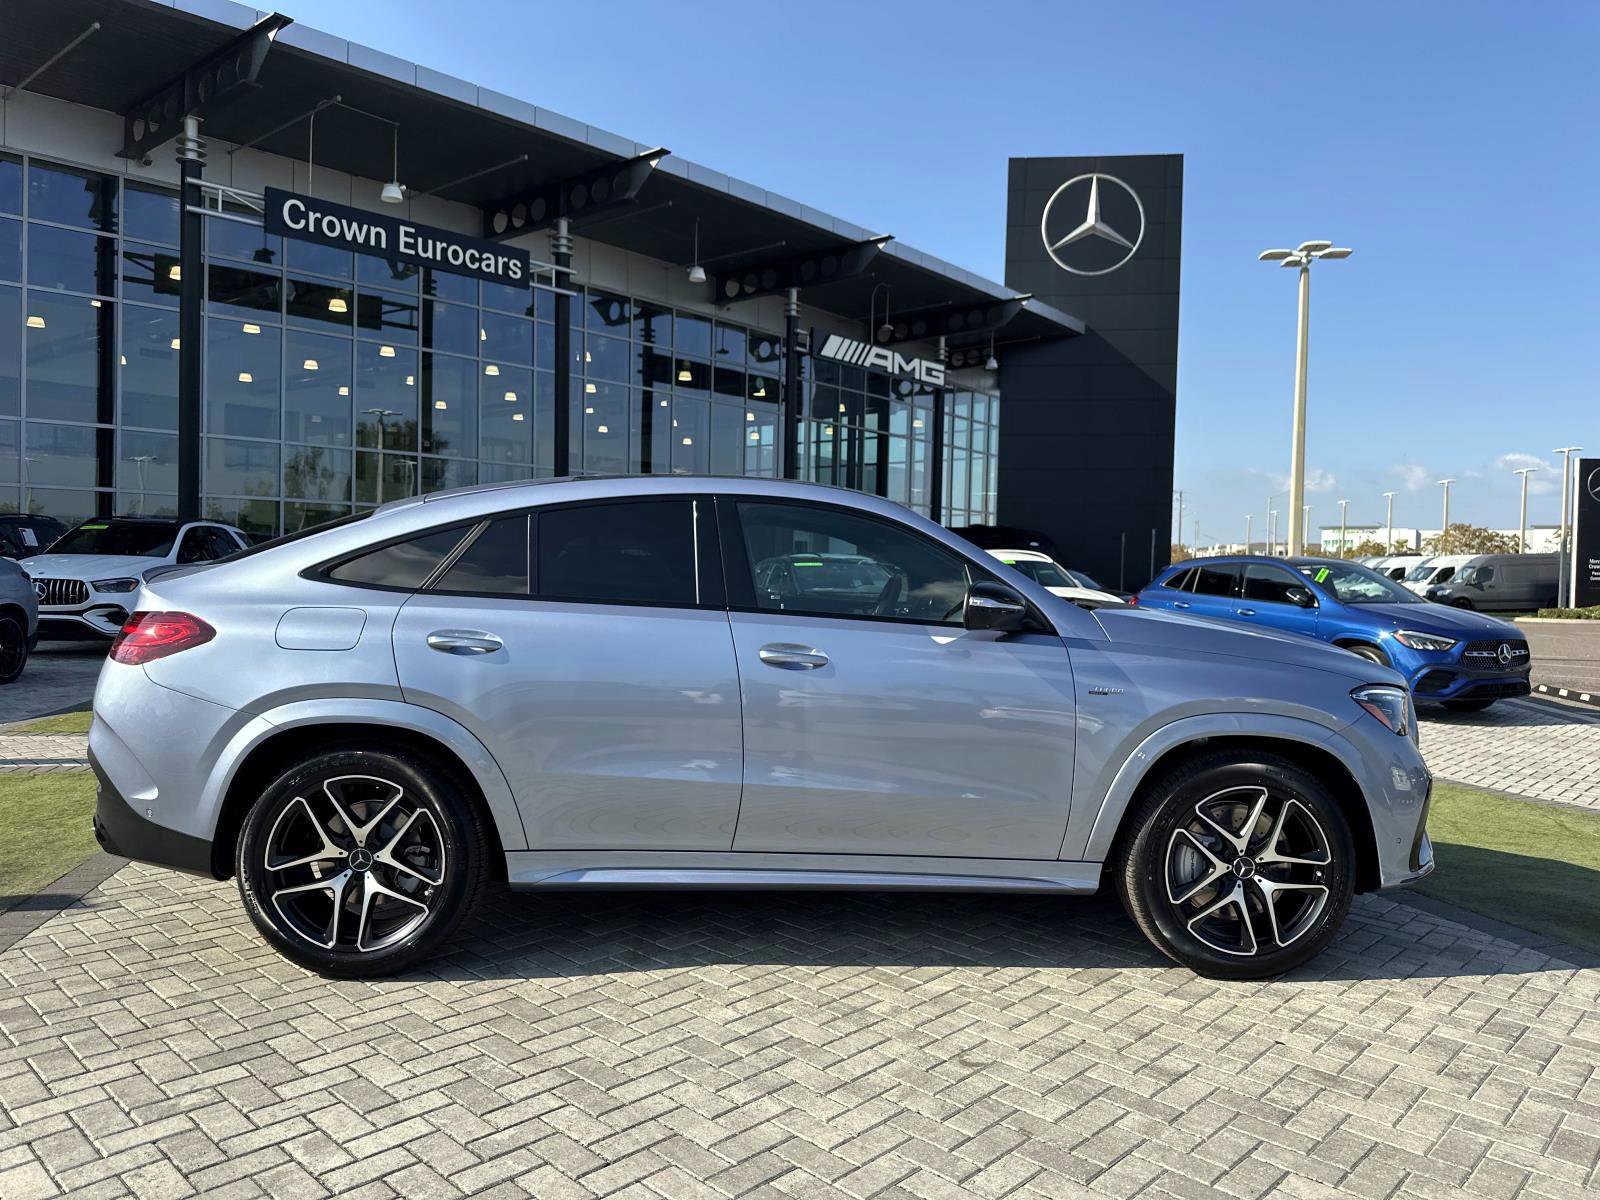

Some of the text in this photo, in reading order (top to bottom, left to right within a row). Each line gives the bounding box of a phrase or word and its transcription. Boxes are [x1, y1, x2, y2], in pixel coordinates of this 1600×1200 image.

[282, 199, 522, 280] Crown Eurocars
[863, 345, 945, 386] AMG
